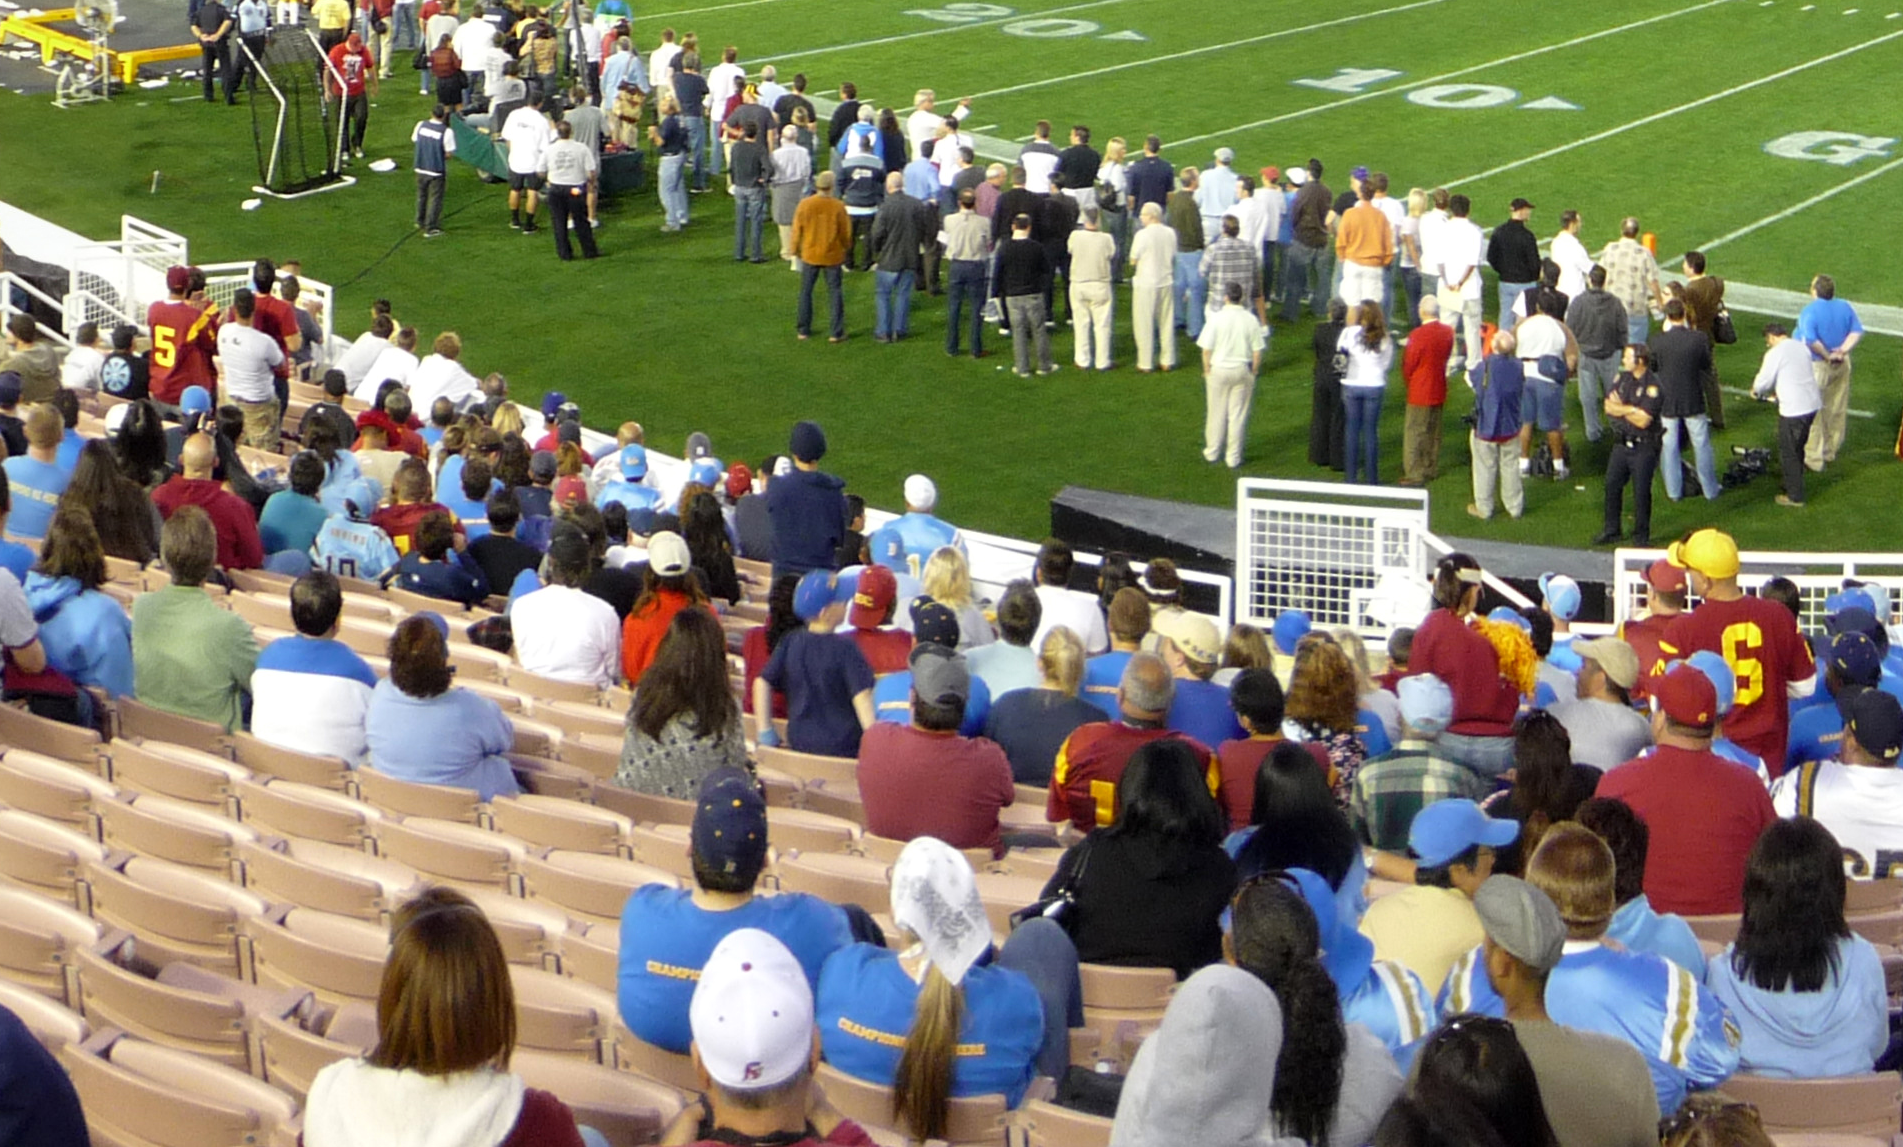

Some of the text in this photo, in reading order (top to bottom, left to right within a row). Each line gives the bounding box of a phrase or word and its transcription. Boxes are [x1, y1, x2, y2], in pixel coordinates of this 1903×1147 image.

[904, 2, 1101, 39] 20
[1291, 66, 1520, 110] 10
[1761, 130, 1900, 166] G
[154, 324, 176, 368] 5
[1721, 621, 1764, 706] 6
